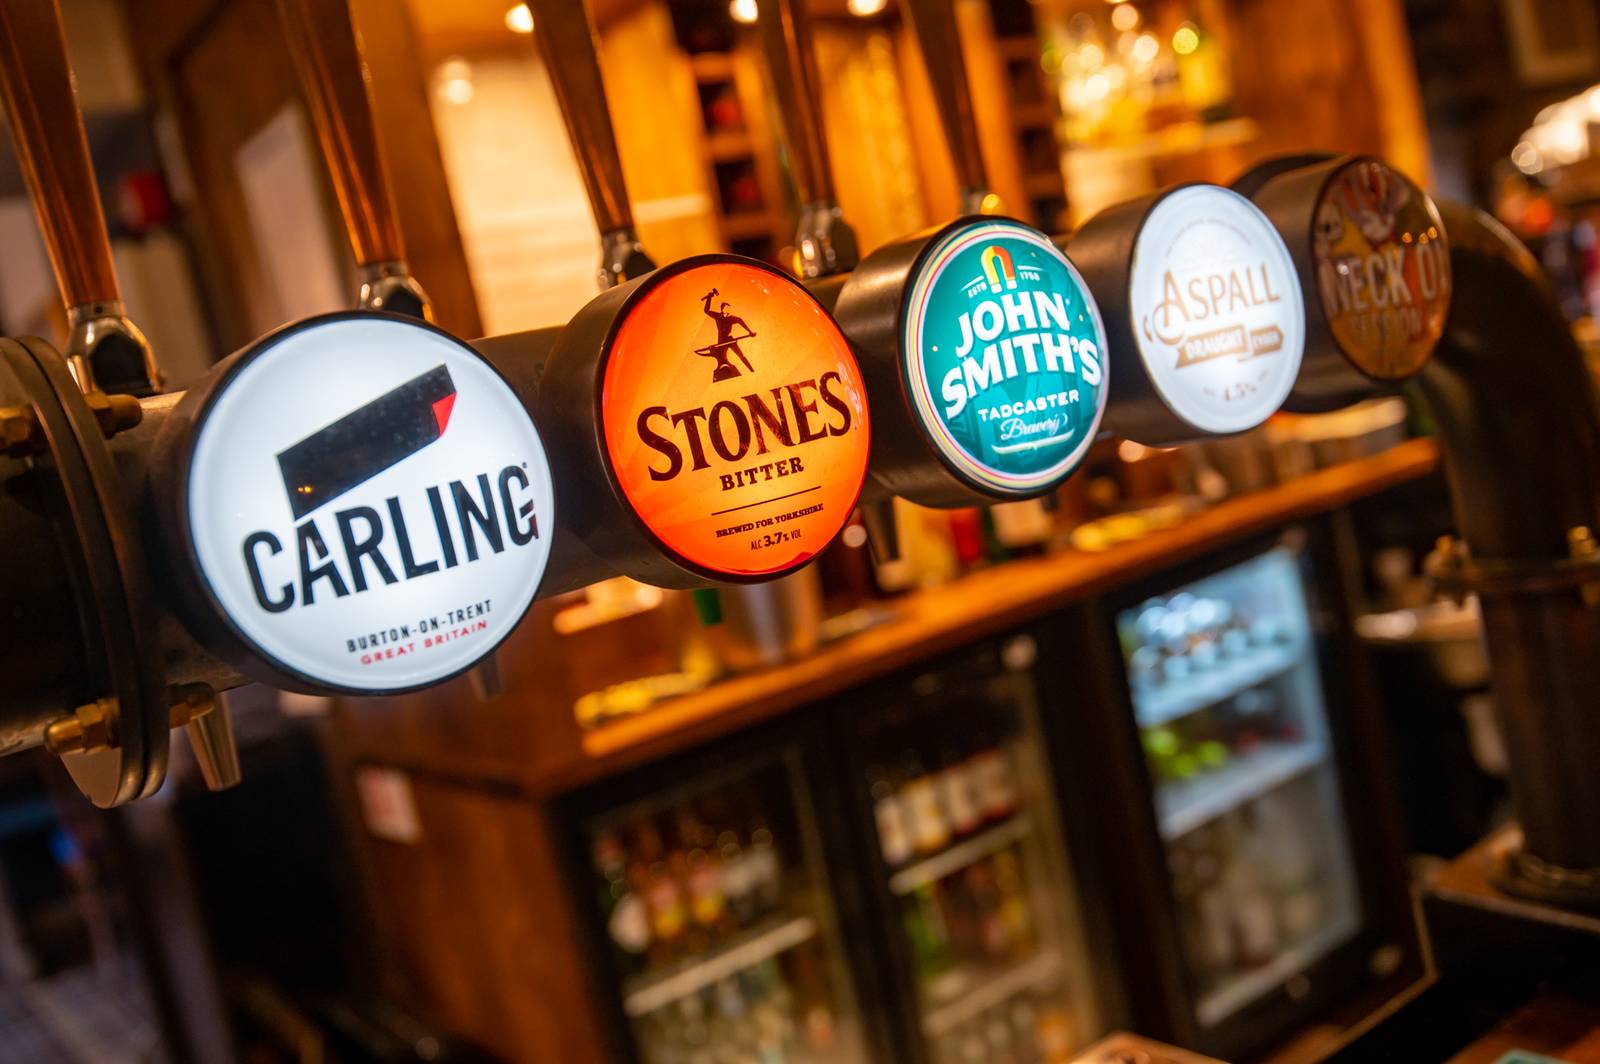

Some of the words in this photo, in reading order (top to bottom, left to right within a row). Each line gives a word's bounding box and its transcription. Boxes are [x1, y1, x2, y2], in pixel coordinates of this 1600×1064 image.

[1319, 245, 1412, 315] NECK
[955, 291, 1071, 357] JOHN
[1185, 329, 1242, 359] DRAUGHT
[941, 332, 1101, 419] SMITH'S
[637, 371, 851, 481] STONES
[978, 389, 1080, 422] TADCASTER
[1000, 411, 1068, 440] Brewery
[719, 457, 804, 491] BITTER
[243, 465, 539, 613] CARLING
[716, 523, 755, 537] BREWED
[756, 518, 774, 528] FOR
[775, 503, 824, 523] YORKSHIRE
[751, 540, 762, 550] ALC
[763, 532, 789, 547] 3.7%
[791, 529, 802, 540] VOL
[347, 599, 493, 653] BURTON-ON-TRENT
[361, 643, 416, 665] GREAT
[424, 620, 489, 649] BRITAIN
